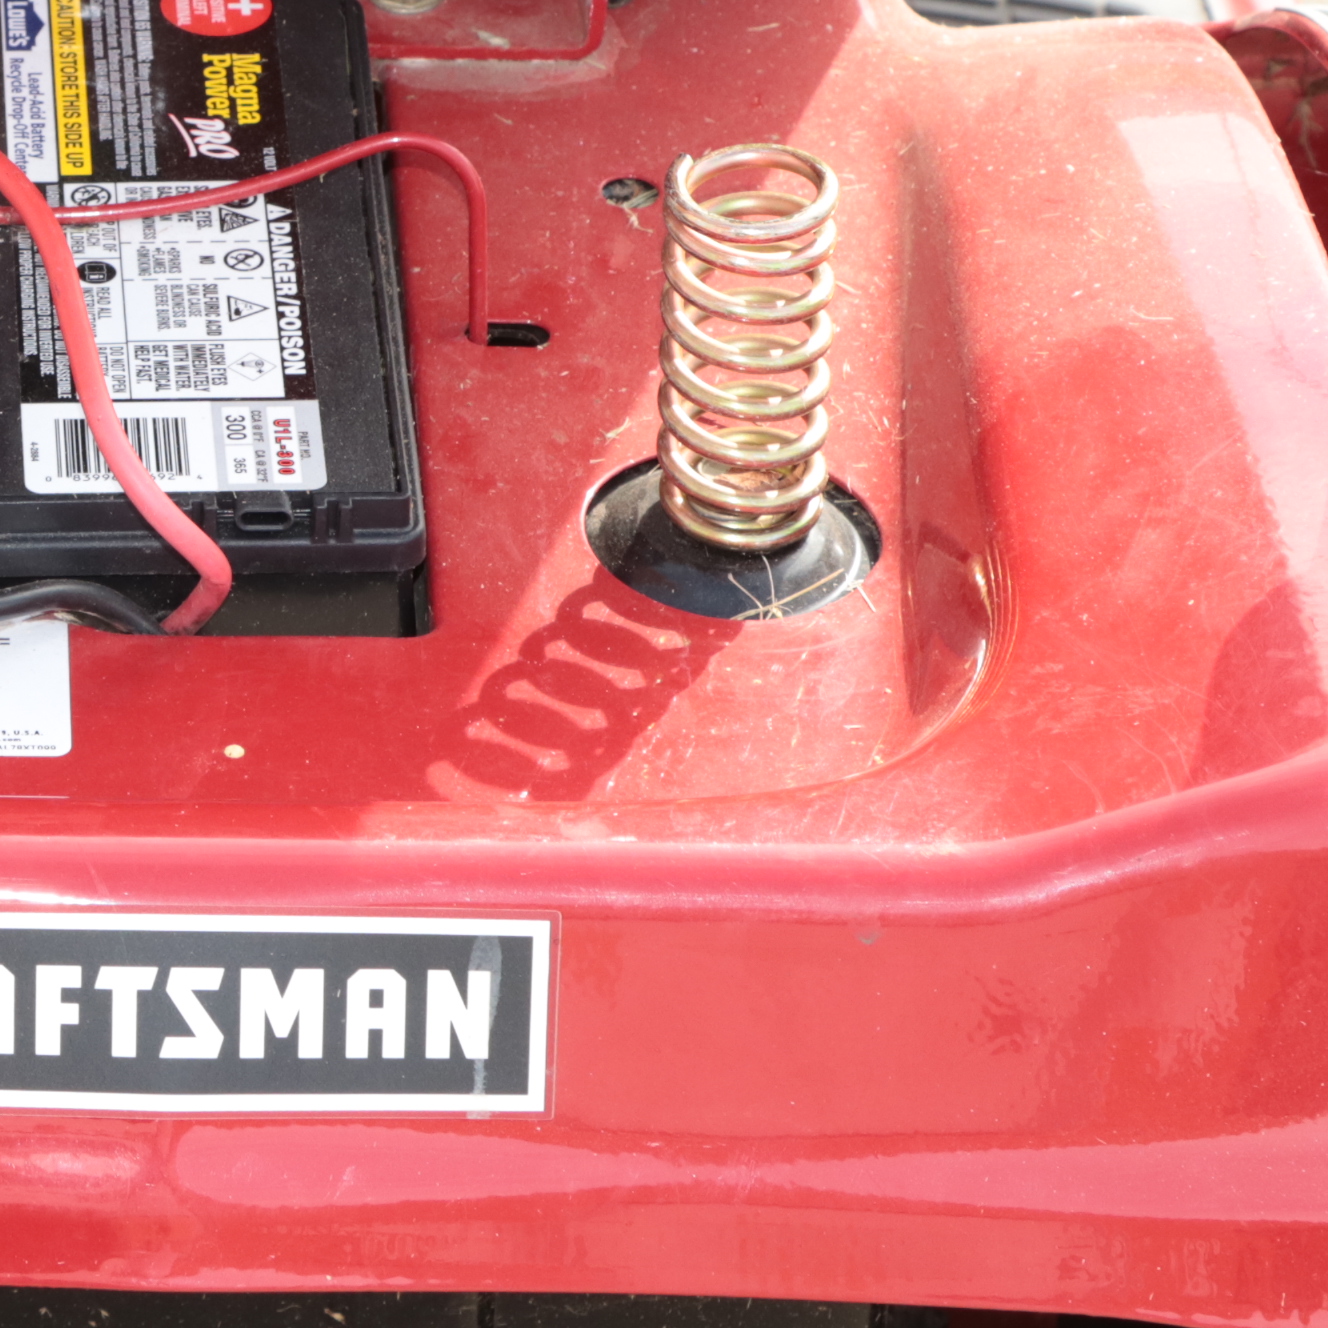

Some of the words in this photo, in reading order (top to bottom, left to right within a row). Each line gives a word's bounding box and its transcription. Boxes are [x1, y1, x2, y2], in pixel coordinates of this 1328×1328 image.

[7, 58, 26, 92] Recycle
[60, 52, 79, 90] STORE
[203, 53, 231, 118] Power
[228, 53, 262, 125] Magna
[28, 73, 46, 120] Lead-Acid
[63, 93, 81, 118] THIS
[8, 97, 29, 139] Drop-Off
[28, 123, 45, 159] Battery
[64, 122, 83, 148] SIDE
[184, 117, 240, 159] PRO
[66, 153, 84, 168] UP
[264, 156, 277, 171] VOLT
[196, 211, 212, 230] EYES.
[70, 232, 84, 254] LDREN
[102, 228, 116, 241] OUT
[103, 244, 117, 252] OF
[19, 250, 33, 275] PROPER
[199, 256, 215, 264] NO
[20, 276, 35, 308] CHARGING
[96, 287, 110, 305] READ
[154, 284, 168, 307] SEVERE
[186, 284, 200, 296] CAN
[202, 284, 221, 317] SULFURIC
[269, 222, 306, 375] DANGER/POISON
[170, 284, 186, 318] BLINDNESS
[188, 298, 202, 317] CAUSE
[38, 317, 52, 329] FOR
[98, 308, 111, 319] ALL
[156, 309, 171, 331] BURNS.
[173, 320, 187, 328] OR
[205, 320, 222, 336] ACID
[39, 330, 53, 360] INVERTED
[110, 347, 124, 356] DO
[134, 345, 151, 362] HELP
[152, 345, 169, 358] GET
[172, 344, 190, 362] WITH
[209, 344, 226, 365] FLUSH
[111, 359, 124, 372] NOT
[136, 365, 152, 383] FAST.
[153, 360, 171, 392] MEDICAL
[191, 344, 210, 392] IMMEDIATELY
[56, 355, 71, 398] DISASSEMBLE
[112, 375, 126, 393] OPEN
[175, 364, 191, 391] WATER.
[211, 368, 228, 385] EYES
[251, 410, 262, 422] CCA
[226, 415, 247, 440] 300
[273, 419, 296, 475] U1L-300
[298, 432, 310, 447] PART
[255, 450, 265, 458] CA
[234, 458, 247, 473] 365
